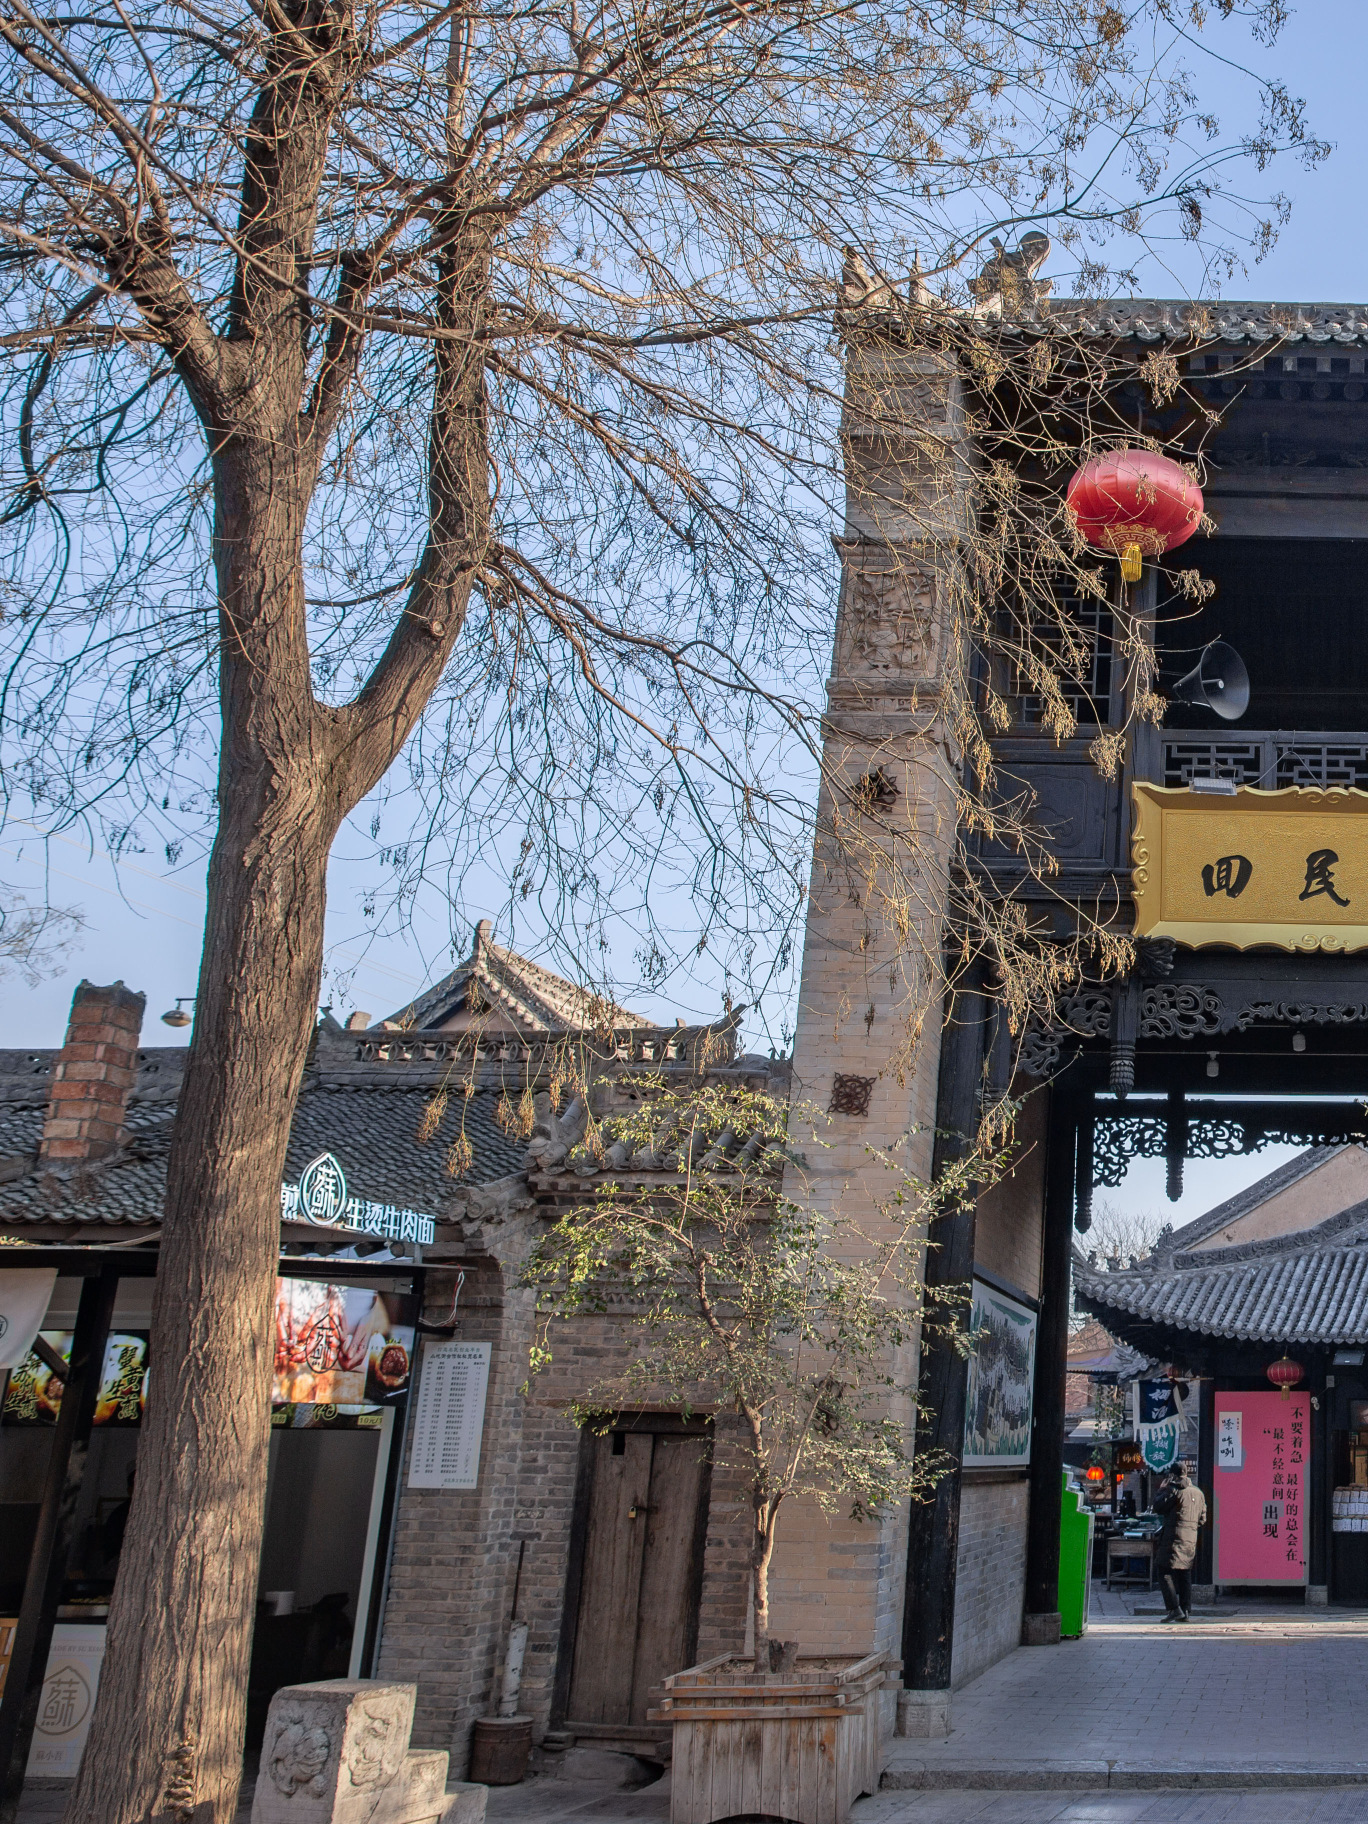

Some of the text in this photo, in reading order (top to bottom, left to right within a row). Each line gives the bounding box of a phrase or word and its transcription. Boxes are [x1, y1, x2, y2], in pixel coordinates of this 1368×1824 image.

[344, 1197, 436, 1245] 生烫牛肉面
[1272, 1428, 1285, 1500] 最不经意间
[1290, 1406, 1304, 1464] 不要着急
[1263, 1504, 1279, 1539] 出现
[1285, 1473, 1299, 1562] 最好的总会在
